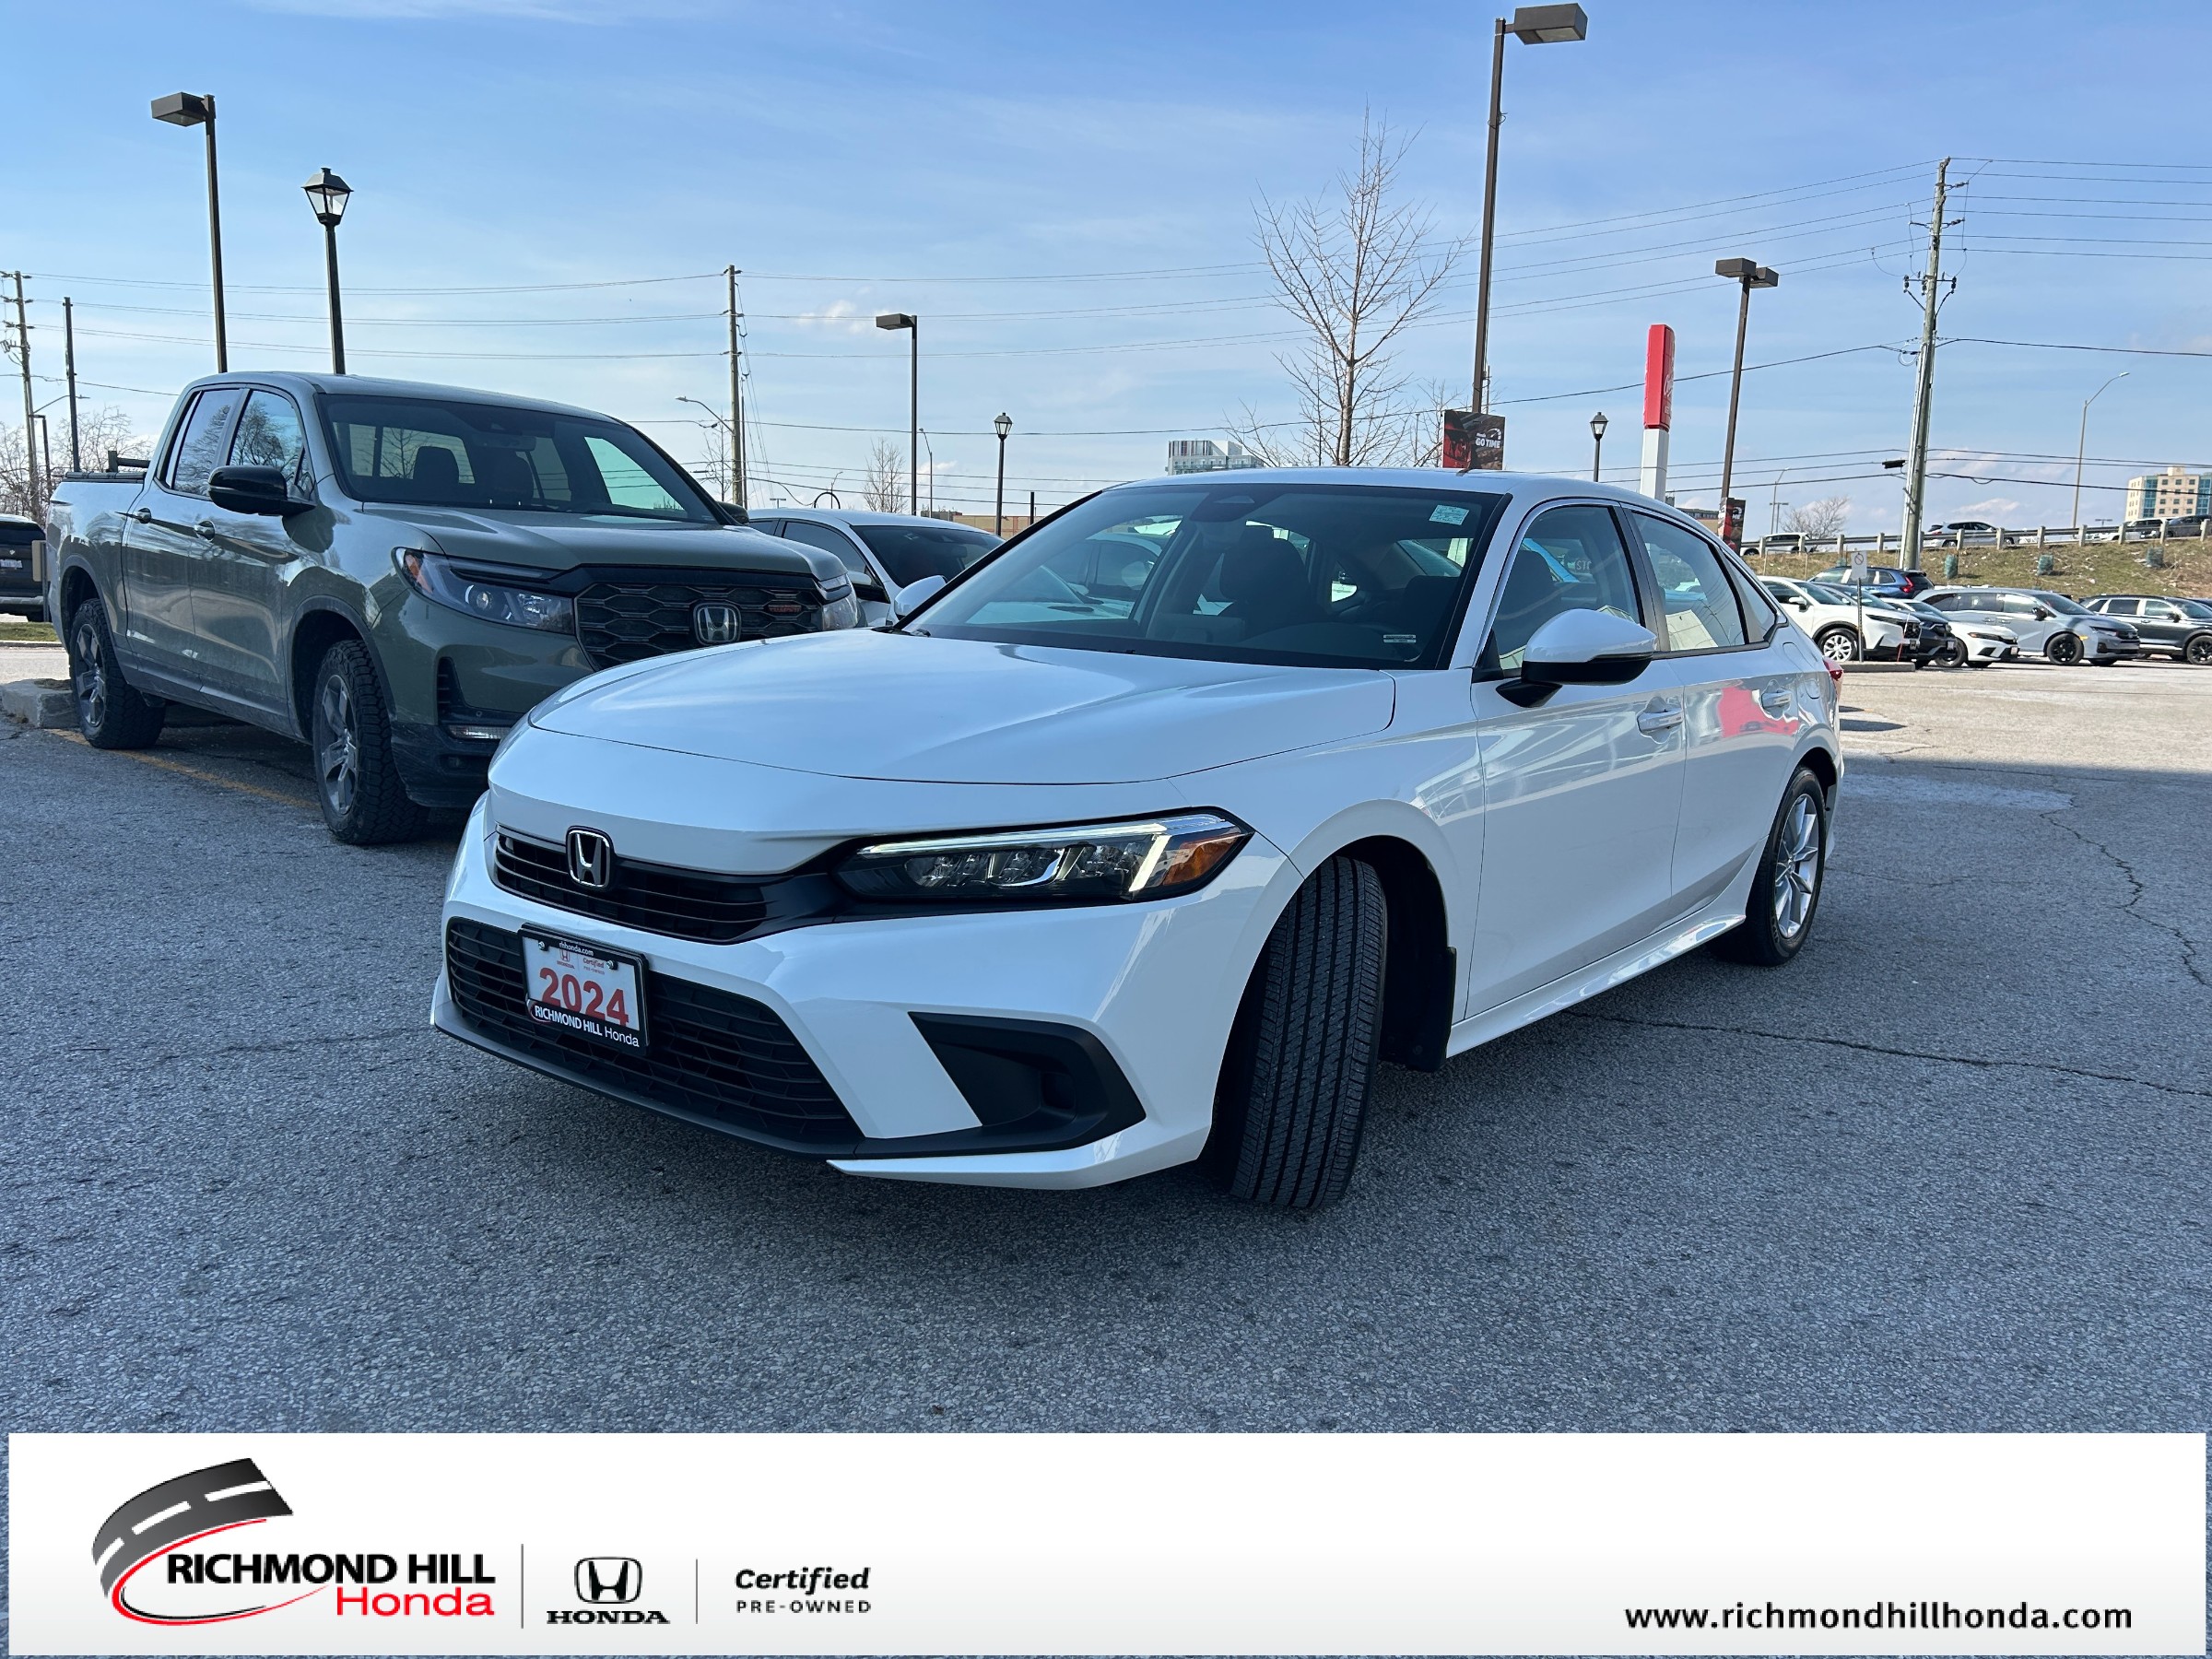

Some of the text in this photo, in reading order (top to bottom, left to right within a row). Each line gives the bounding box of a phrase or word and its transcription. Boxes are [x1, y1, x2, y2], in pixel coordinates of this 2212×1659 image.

[1476, 438, 1500, 448] GO TIME
[1576, 559, 1592, 571] STO
[539, 968, 629, 1027] 2024
[535, 1005, 640, 1048] RICHMOND HILL Honda
